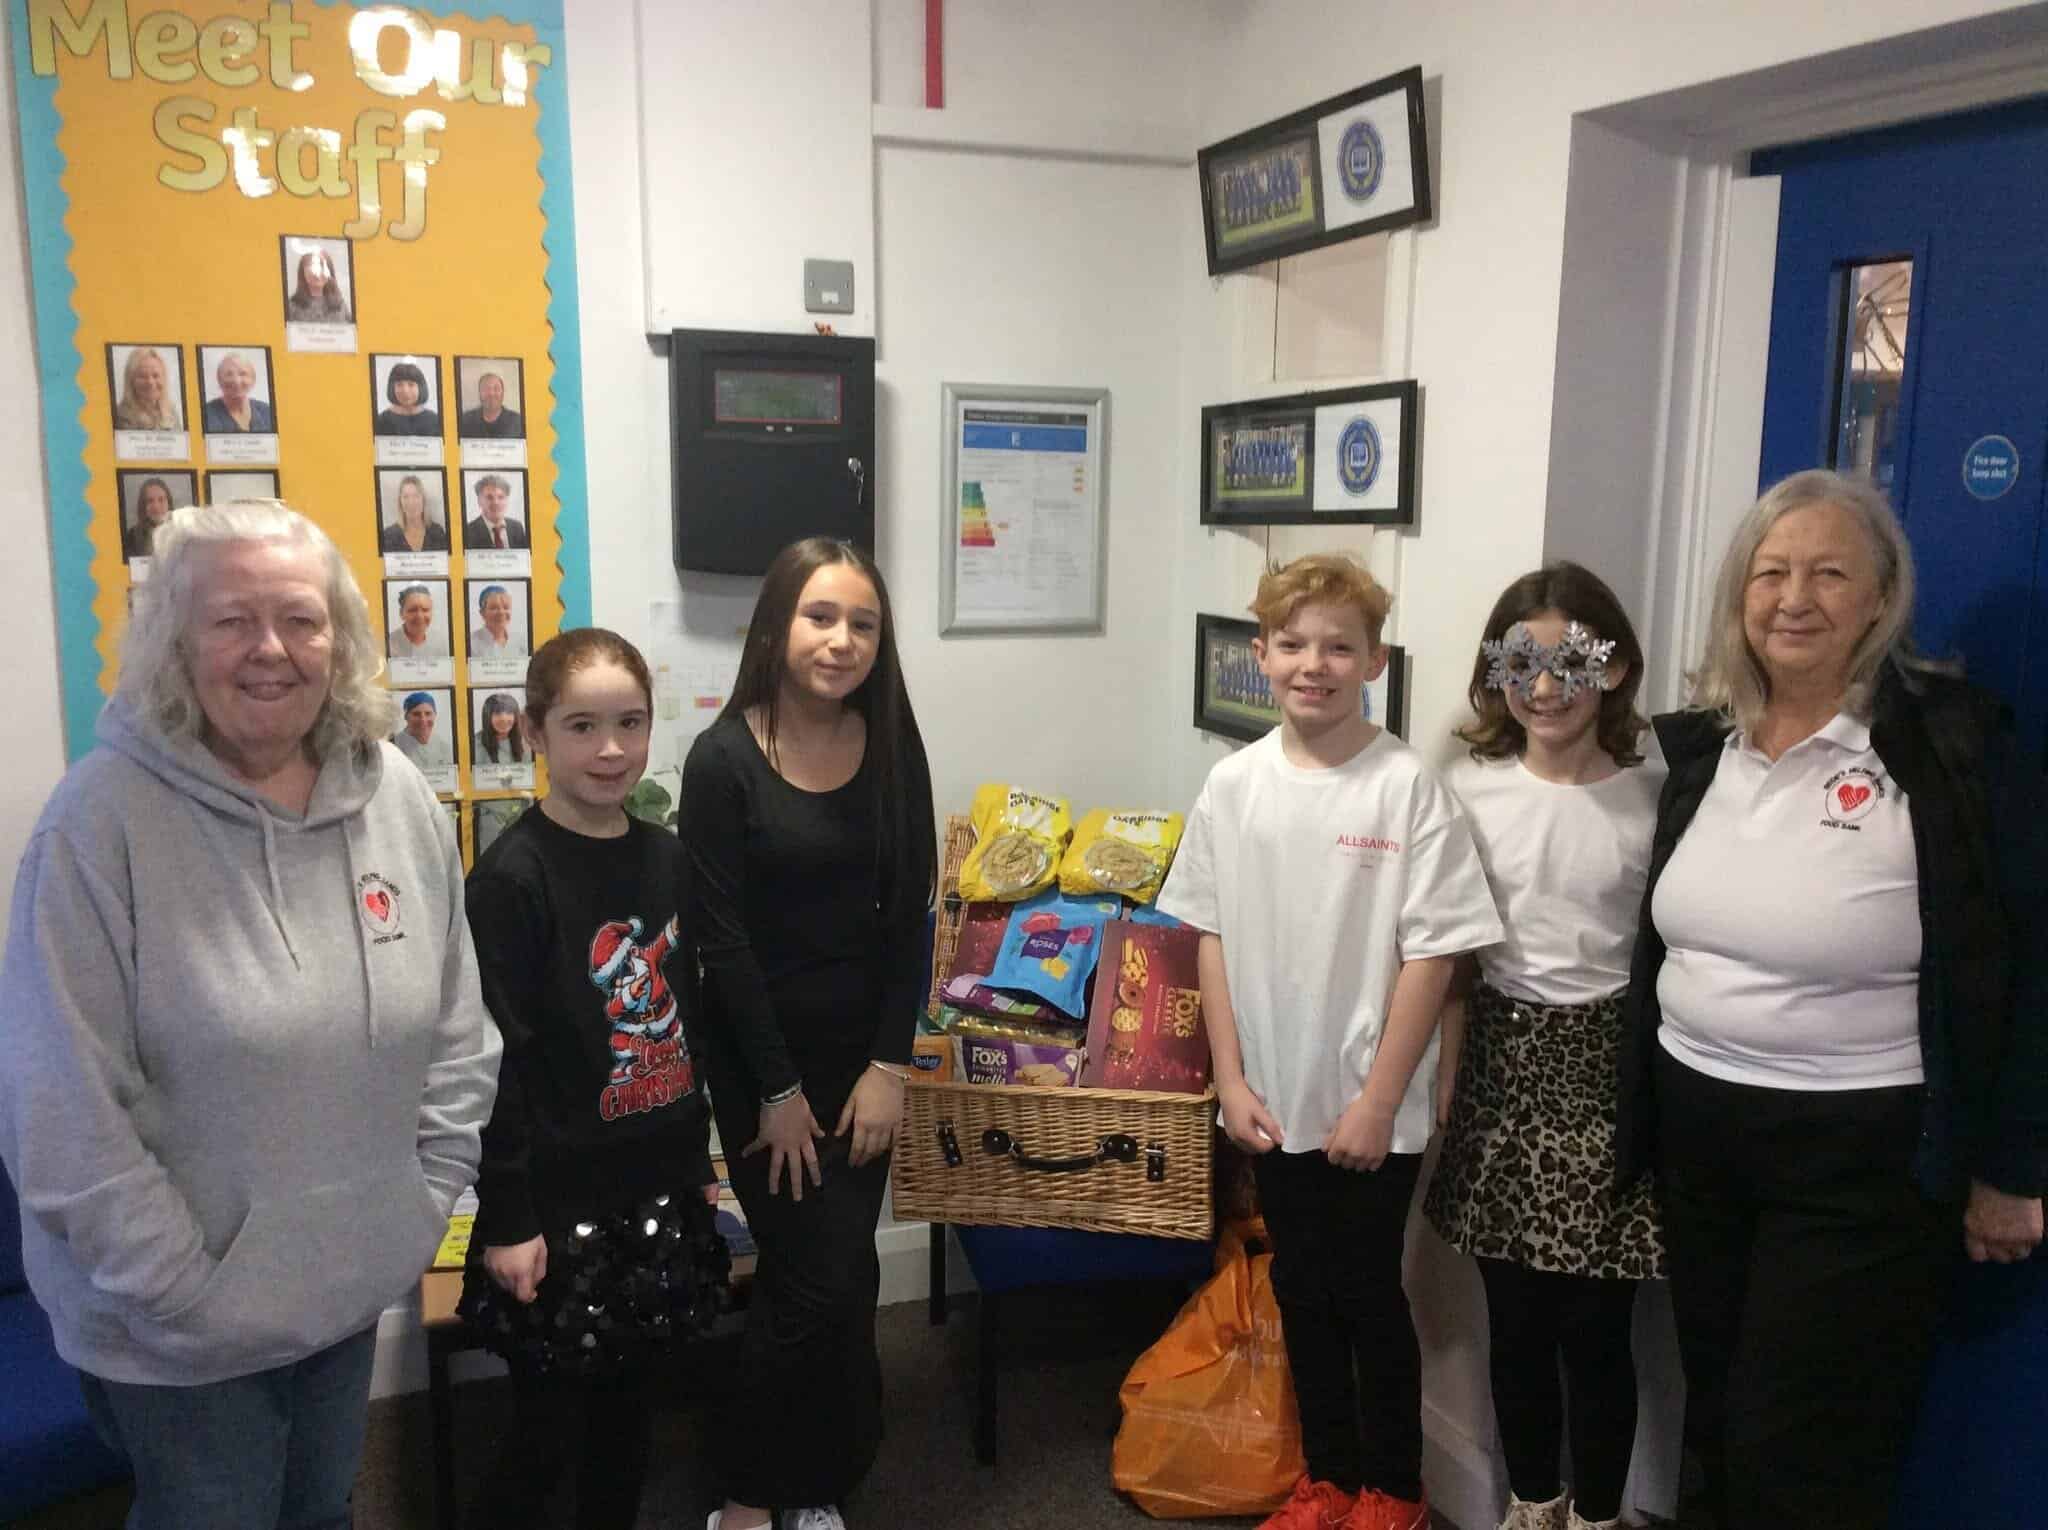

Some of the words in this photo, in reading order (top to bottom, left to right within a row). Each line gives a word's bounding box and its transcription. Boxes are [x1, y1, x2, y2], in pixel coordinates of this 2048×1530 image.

[28, 0, 314, 92] Meet
[349, 7, 552, 106] Our
[152, 95, 446, 241] Staff
[1336, 833, 1401, 854] ALLSAINTS
[1030, 938, 1059, 951] ROSES
